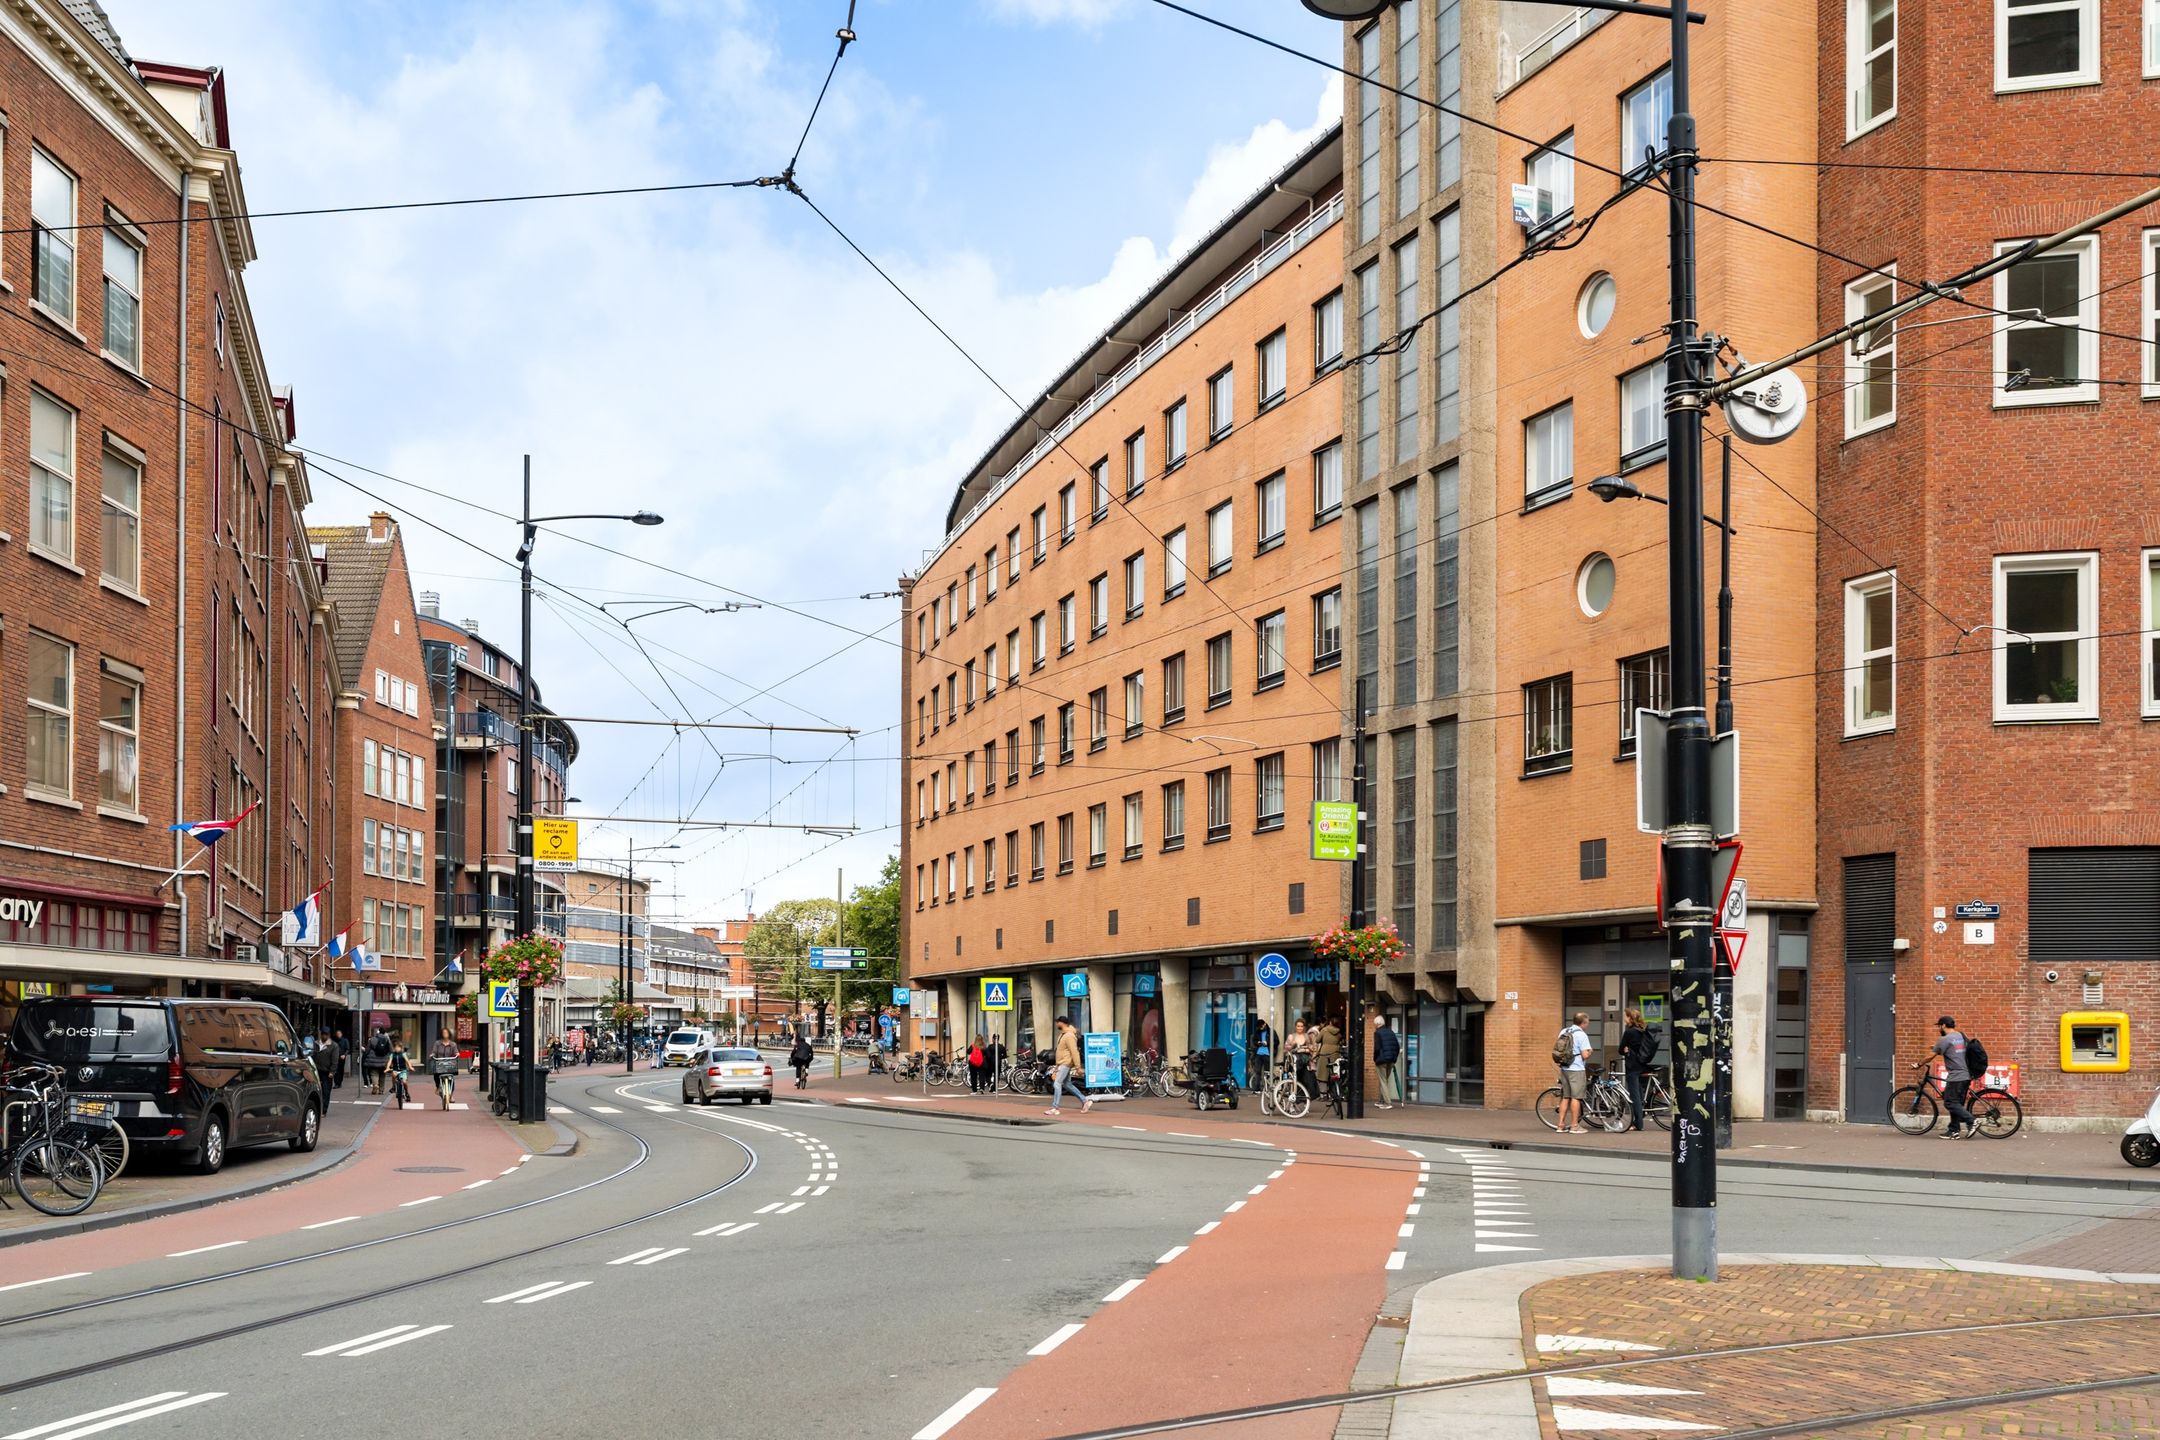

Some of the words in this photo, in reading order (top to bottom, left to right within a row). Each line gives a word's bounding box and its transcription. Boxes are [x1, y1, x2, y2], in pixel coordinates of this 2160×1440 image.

[1320, 806, 1352, 814] Amazing
[0, 897, 44, 929] any
[1975, 928, 1983, 938] B
[1294, 961, 1332, 982] Albert
